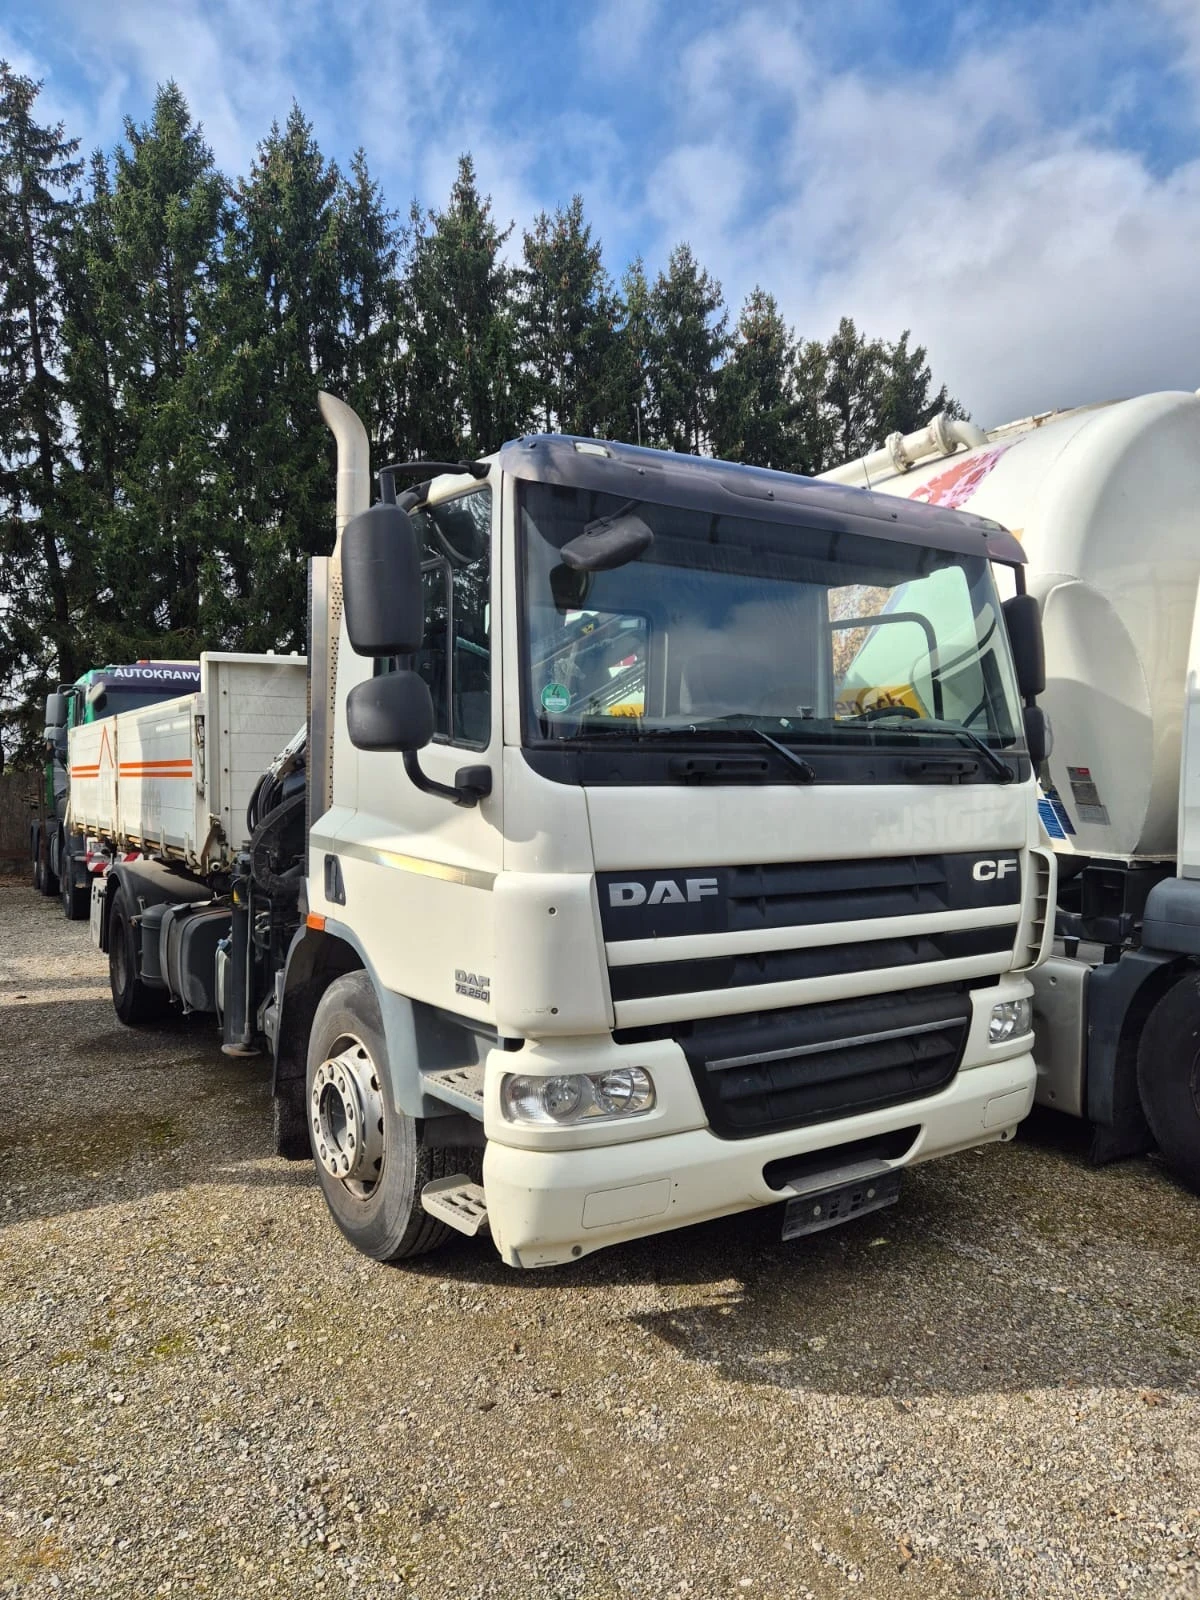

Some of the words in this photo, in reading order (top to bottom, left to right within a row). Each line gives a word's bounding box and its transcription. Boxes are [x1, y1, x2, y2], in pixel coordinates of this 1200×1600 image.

[972, 859, 1017, 881] CF
[608, 878, 719, 907] DAF
[455, 969, 490, 989] DAF
